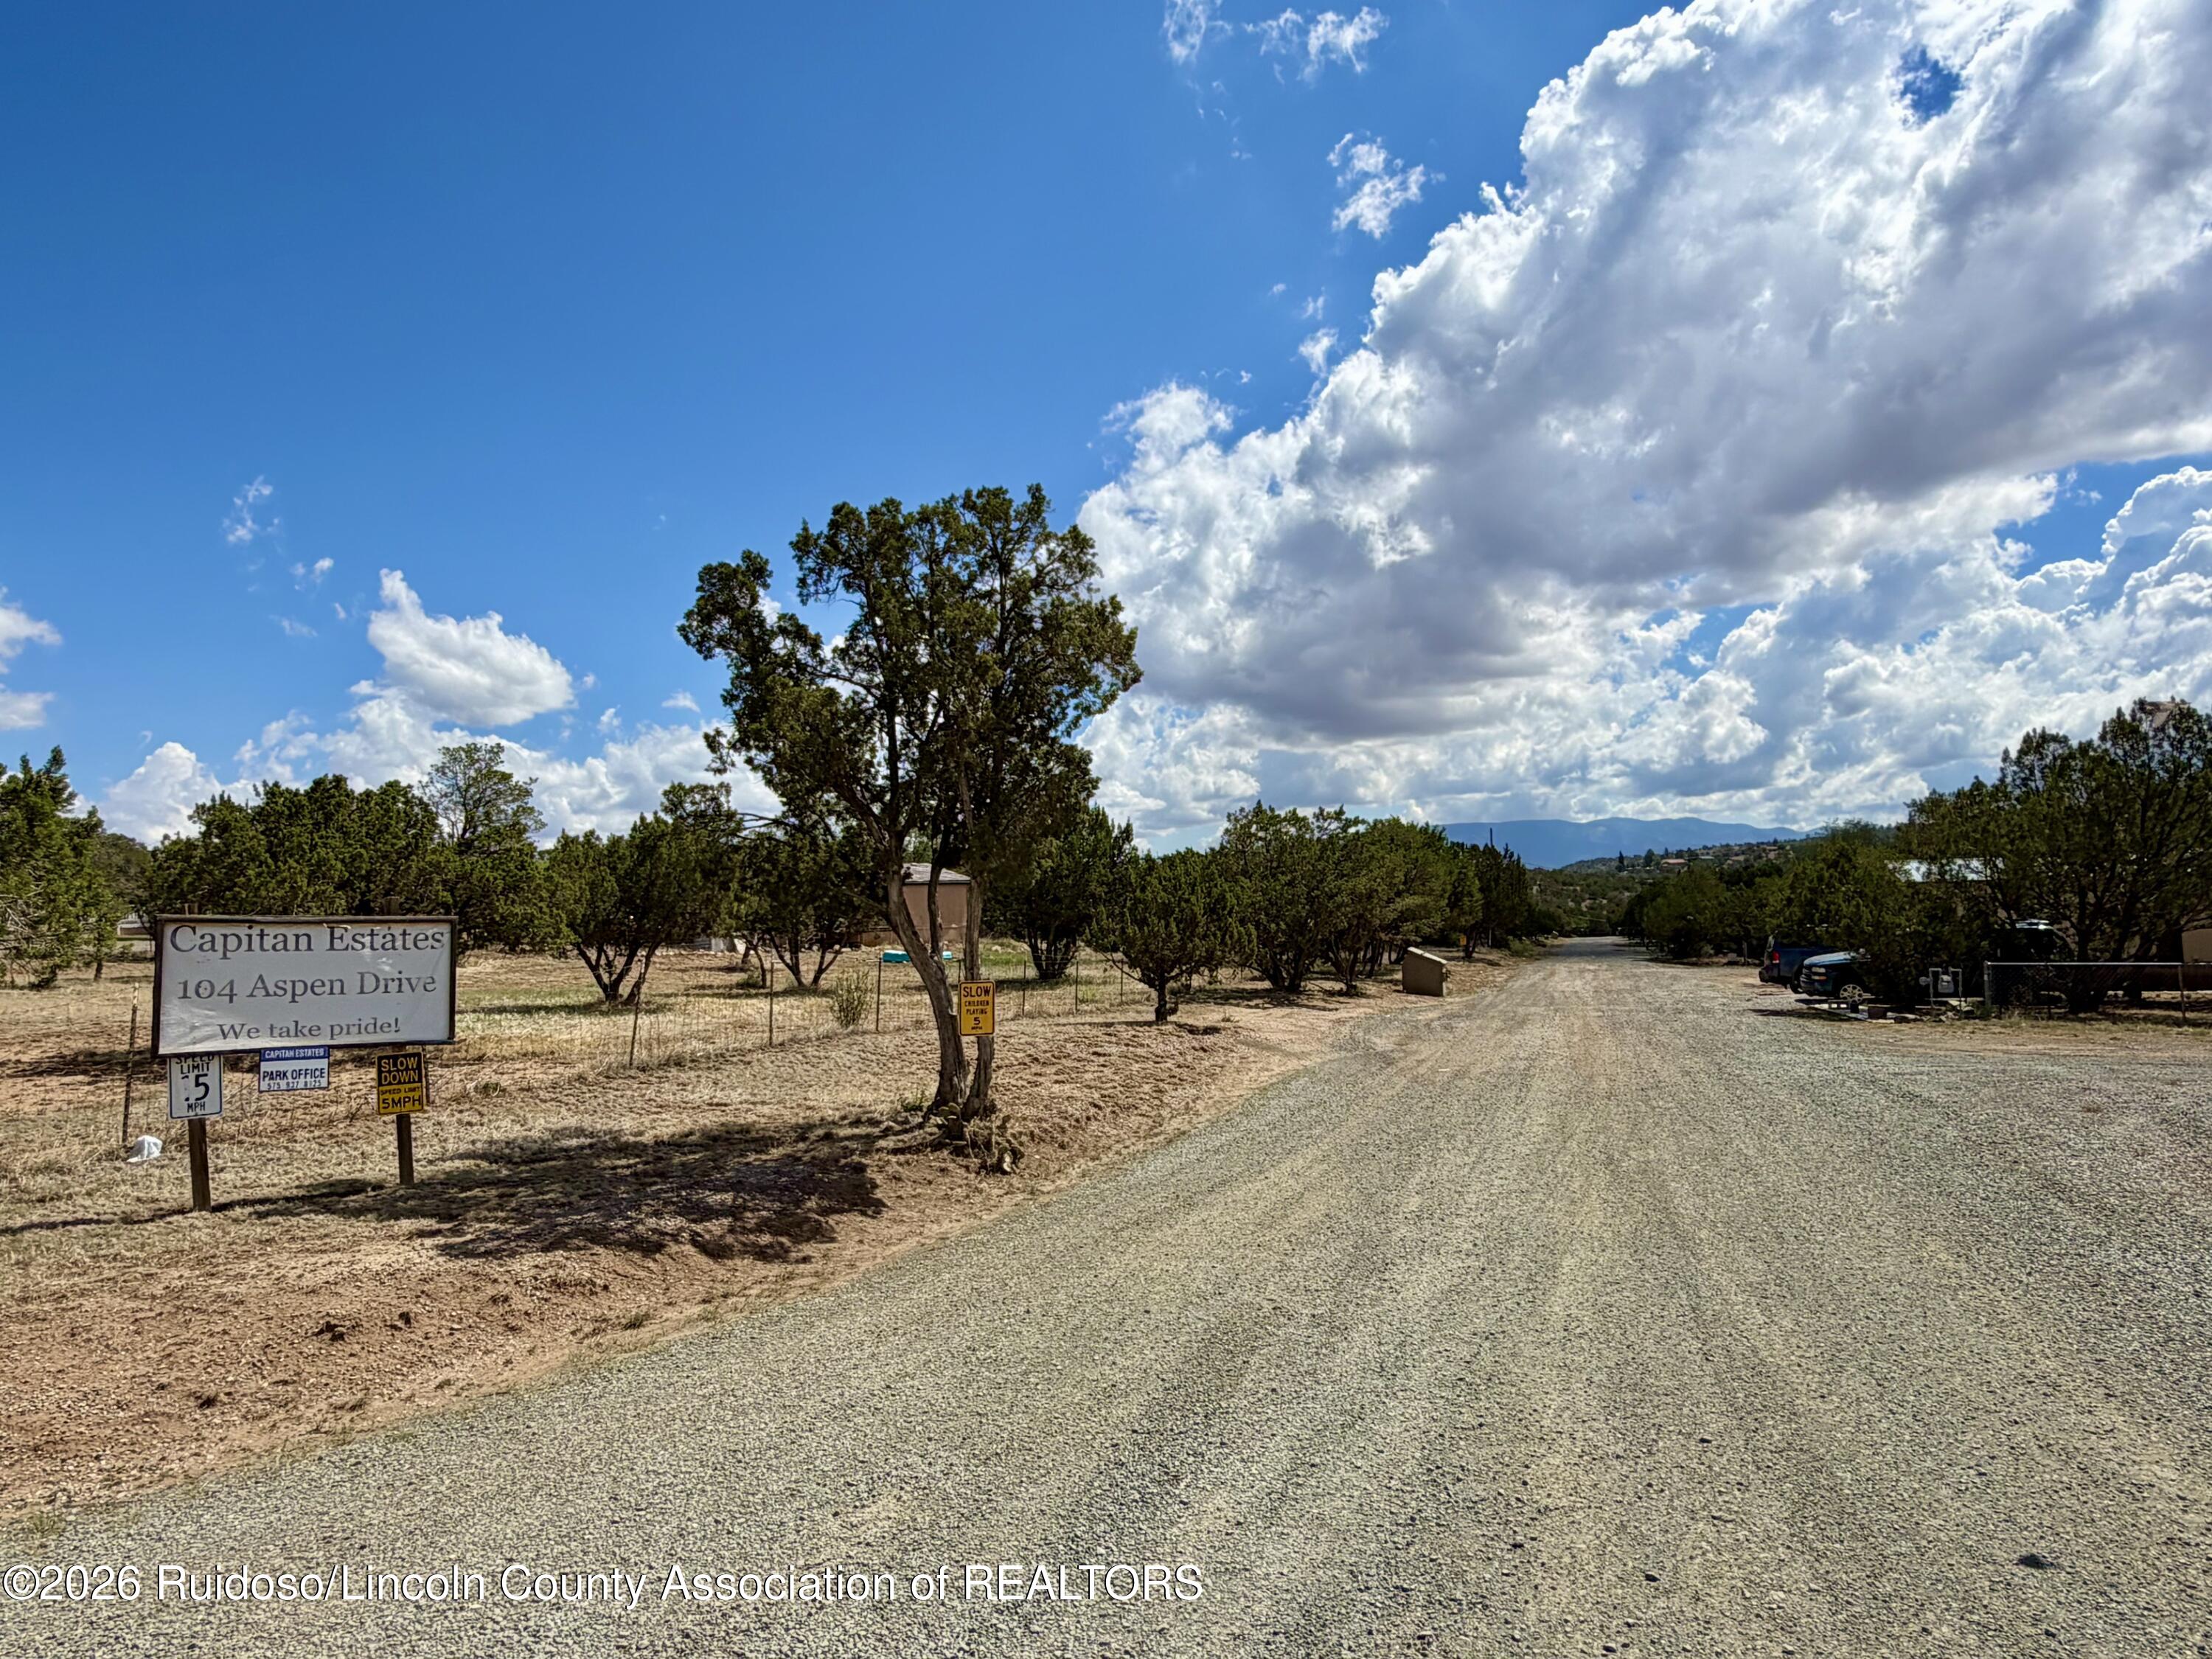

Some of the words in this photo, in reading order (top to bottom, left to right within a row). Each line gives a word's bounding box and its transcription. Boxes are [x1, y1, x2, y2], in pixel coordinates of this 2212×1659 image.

[170, 925, 314, 960] Capitan
[325, 925, 445, 952] Estates
[178, 978, 237, 1004] 104
[246, 973, 347, 1004] Aspen
[357, 970, 437, 995] Drive
[963, 986, 991, 998] SLOW
[973, 1017, 981, 1025] 5
[217, 1023, 260, 1040] We
[269, 1020, 321, 1039] take
[329, 1017, 400, 1040] pride!
[265, 1049, 294, 1058] CAPITAN
[296, 1048, 324, 1057] ESTATES
[180, 1062, 210, 1074] LIMIT
[381, 1056, 418, 1071] SLOW
[262, 1069, 288, 1082] PARK
[291, 1068, 326, 1080] OFFICE
[381, 1069, 419, 1085] DOWN
[187, 1102, 206, 1113] MPH
[382, 1095, 420, 1109] 5MPH
